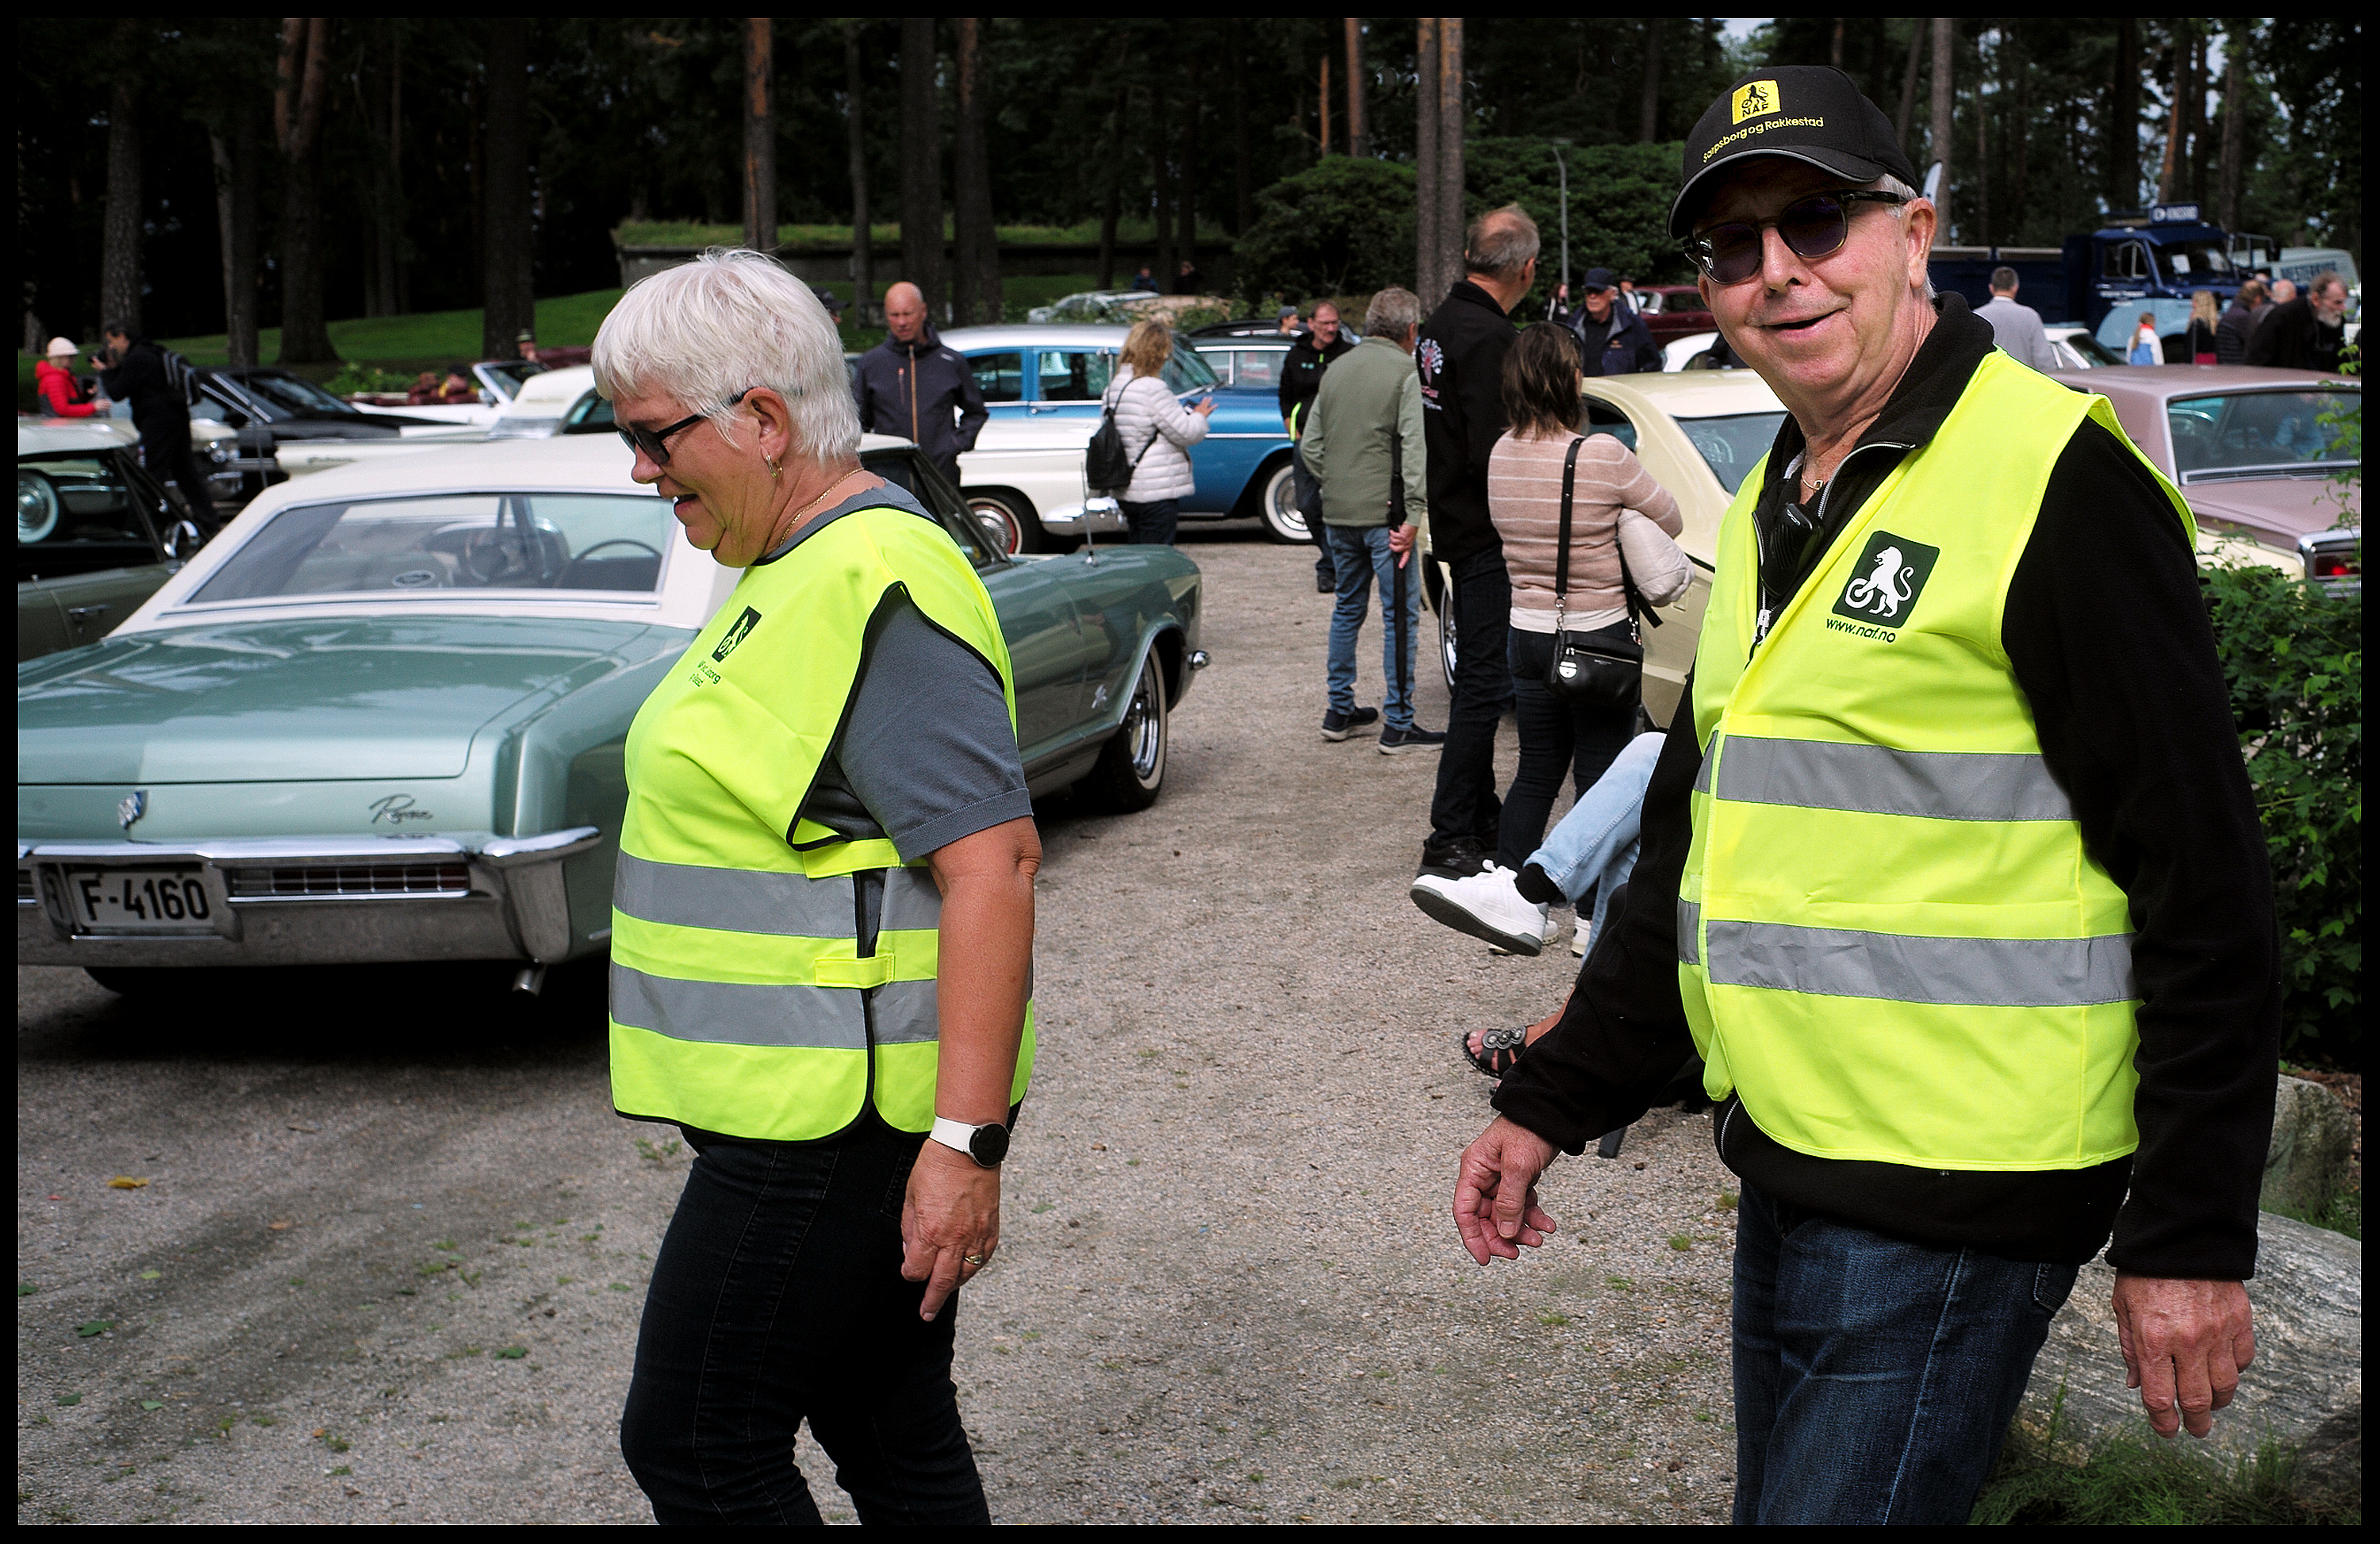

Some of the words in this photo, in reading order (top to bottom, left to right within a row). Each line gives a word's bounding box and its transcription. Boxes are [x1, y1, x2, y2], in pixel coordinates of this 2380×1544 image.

[1742, 102, 1769, 117] NAF
[1702, 128, 1748, 163] Sarpsborg
[1748, 123, 1764, 134] og
[1764, 117, 1824, 129] Rakkestad
[1825, 618, 1896, 643] www.naf.no
[80, 878, 209, 920] F-4160
